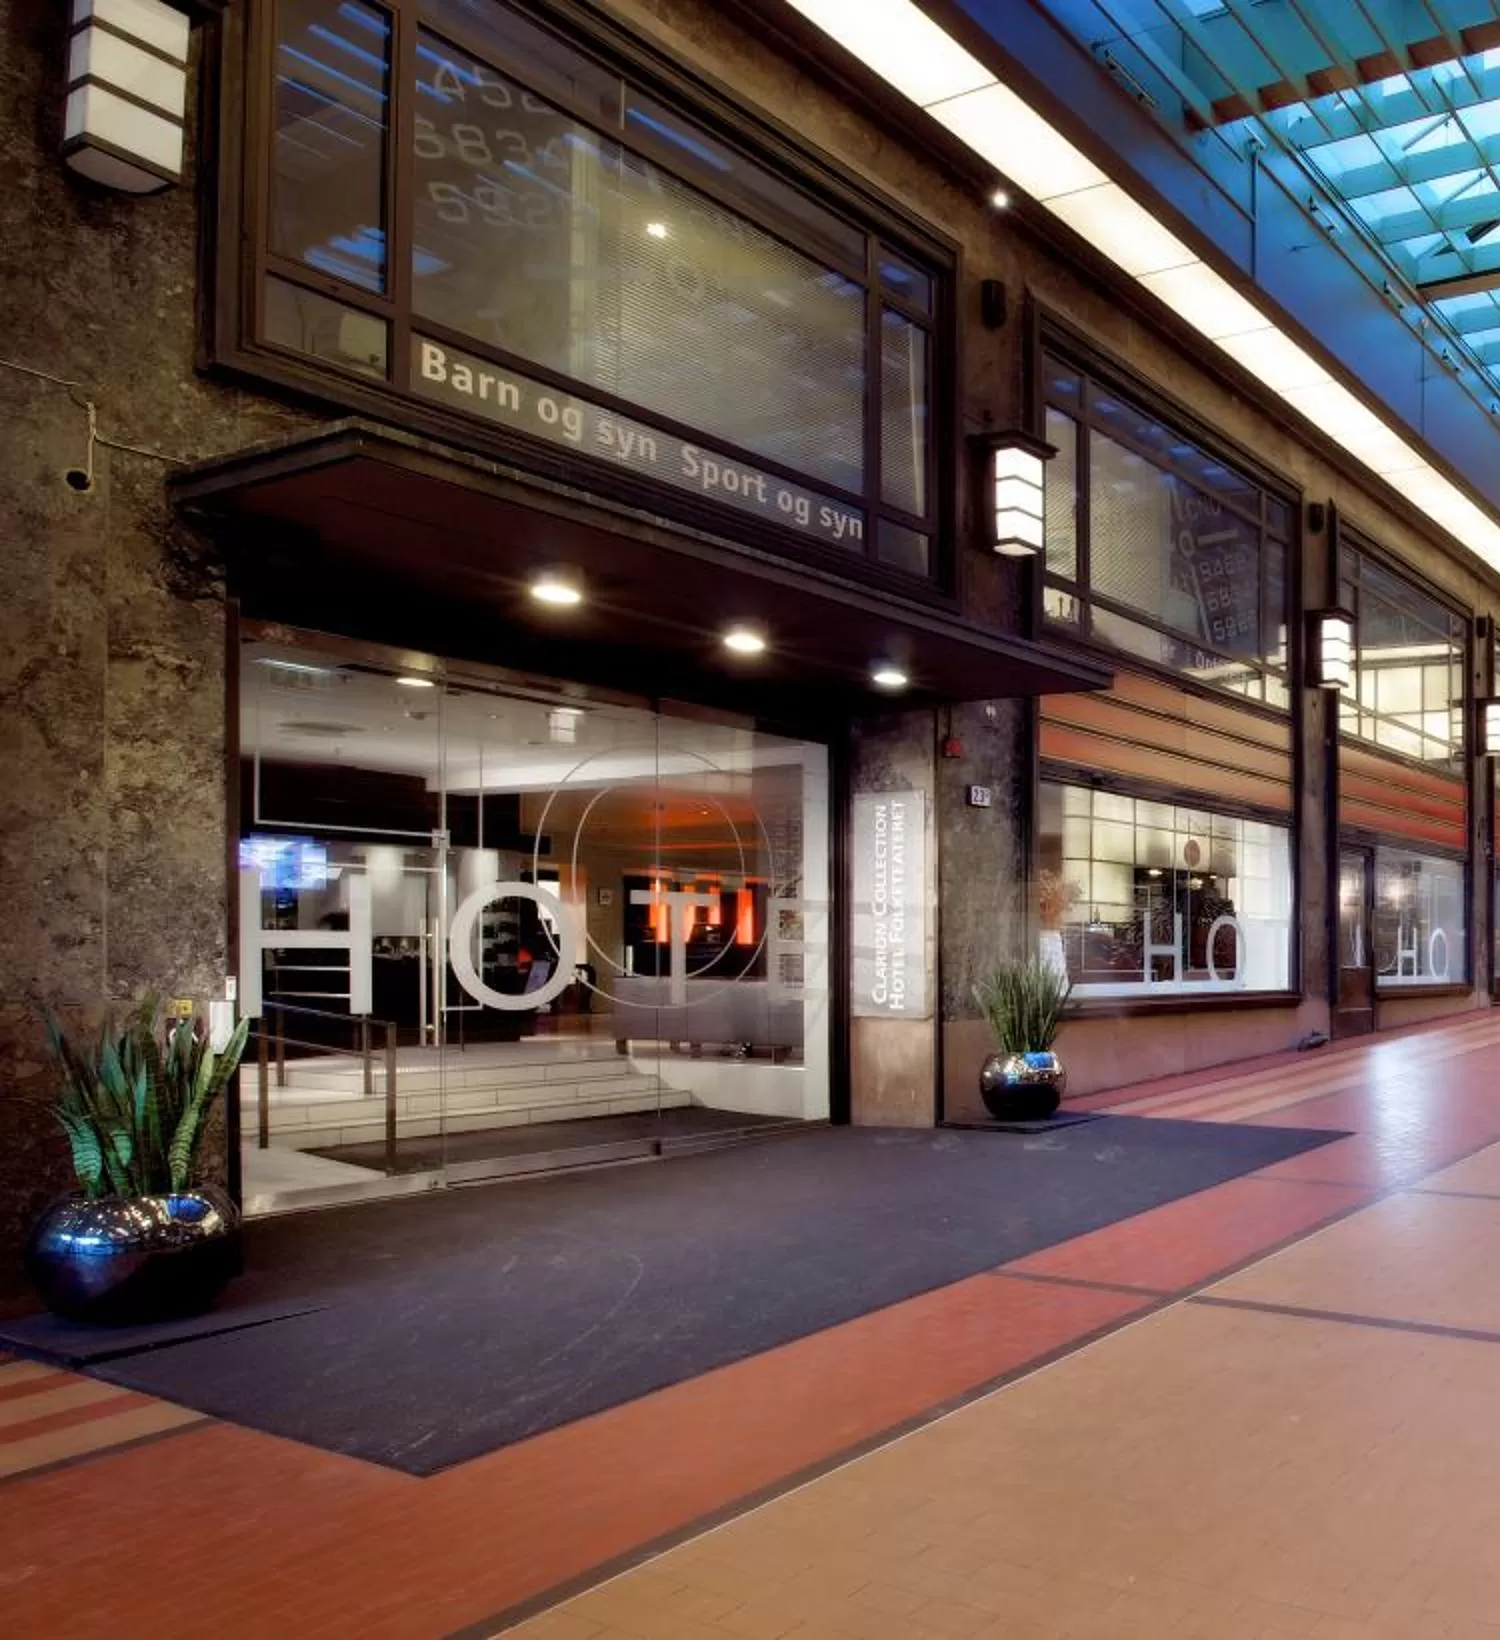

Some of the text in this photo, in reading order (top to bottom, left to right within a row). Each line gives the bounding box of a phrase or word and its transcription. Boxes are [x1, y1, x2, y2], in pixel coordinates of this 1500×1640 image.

[421, 342, 863, 540] Barn og syn Sport og syn
